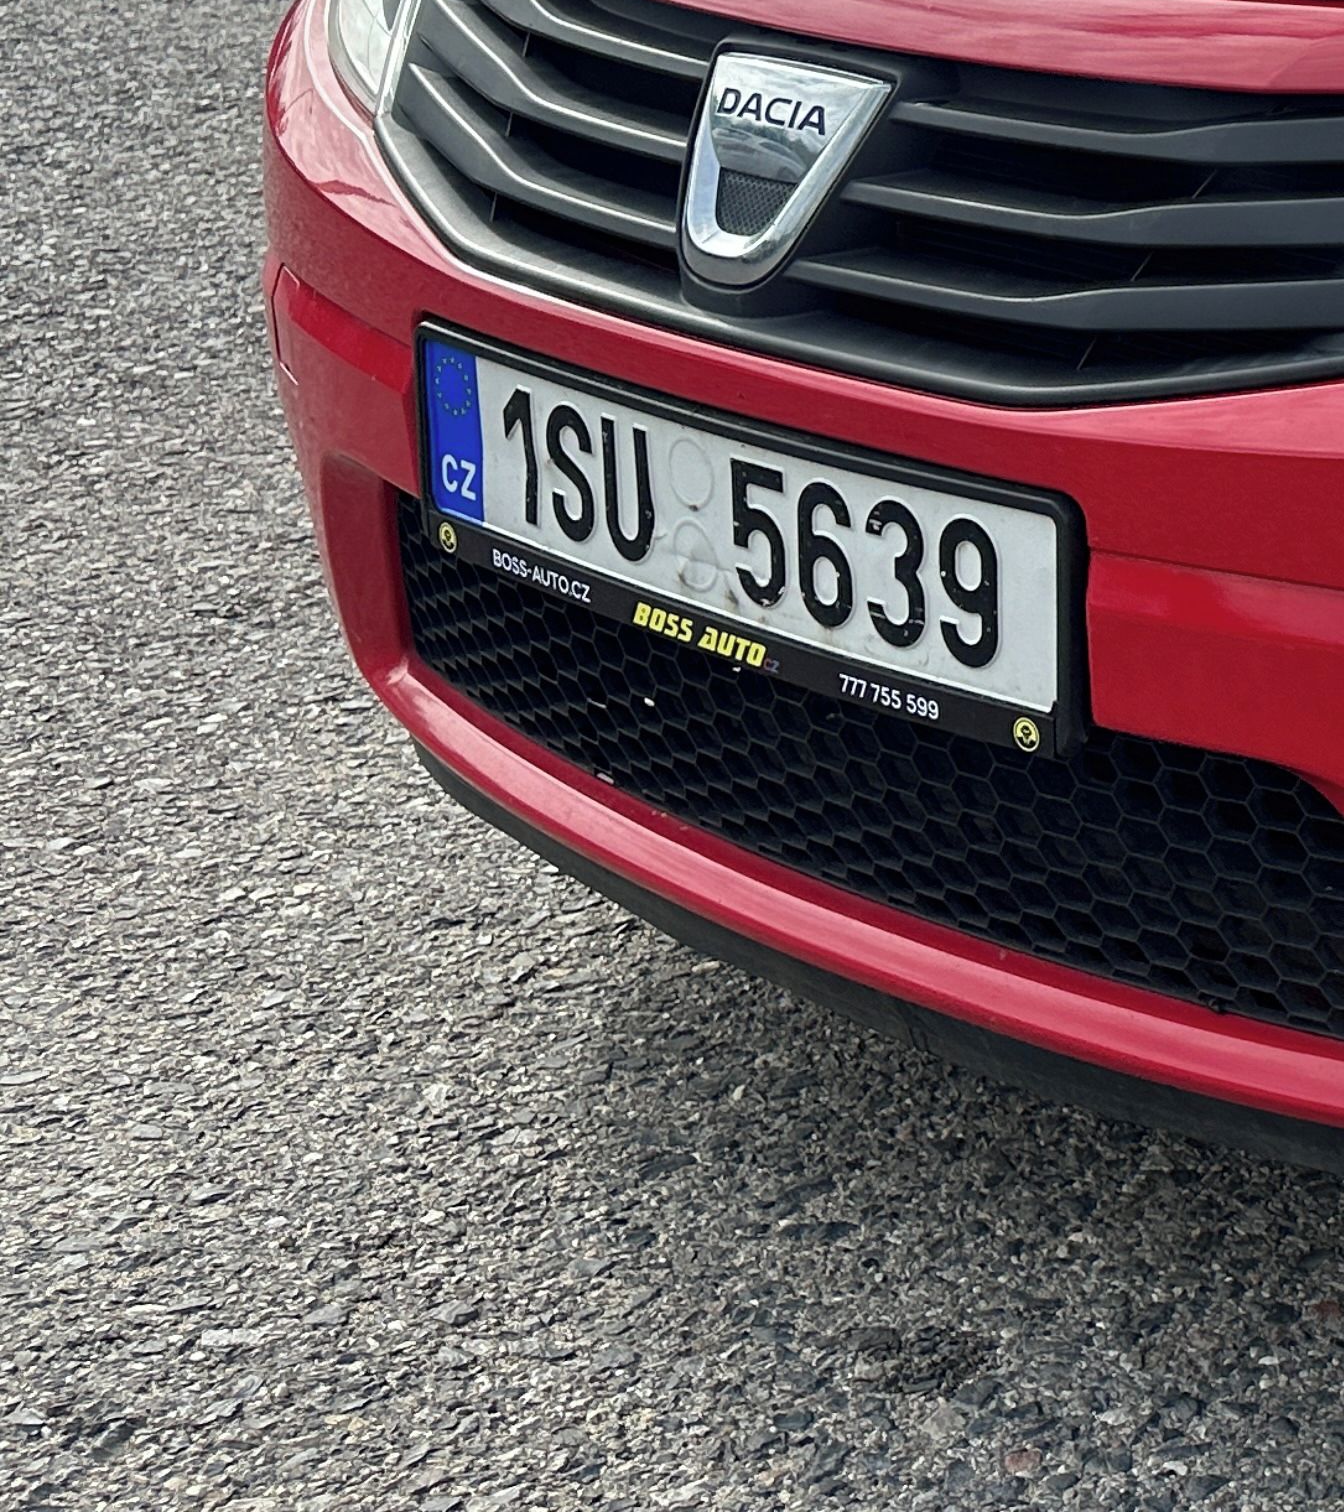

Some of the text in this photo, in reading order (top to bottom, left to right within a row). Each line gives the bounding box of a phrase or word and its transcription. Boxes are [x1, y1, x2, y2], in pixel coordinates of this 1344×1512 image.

[716, 87, 827, 136] DACIA
[441, 454, 477, 501] CZ
[503, 385, 1001, 670] 1SU 5639
[492, 548, 592, 604] BOSS-AUTO.CZ
[632, 601, 694, 643] BOSS
[697, 626, 767, 668] AUTO
[839, 673, 940, 720] 777 755 599
